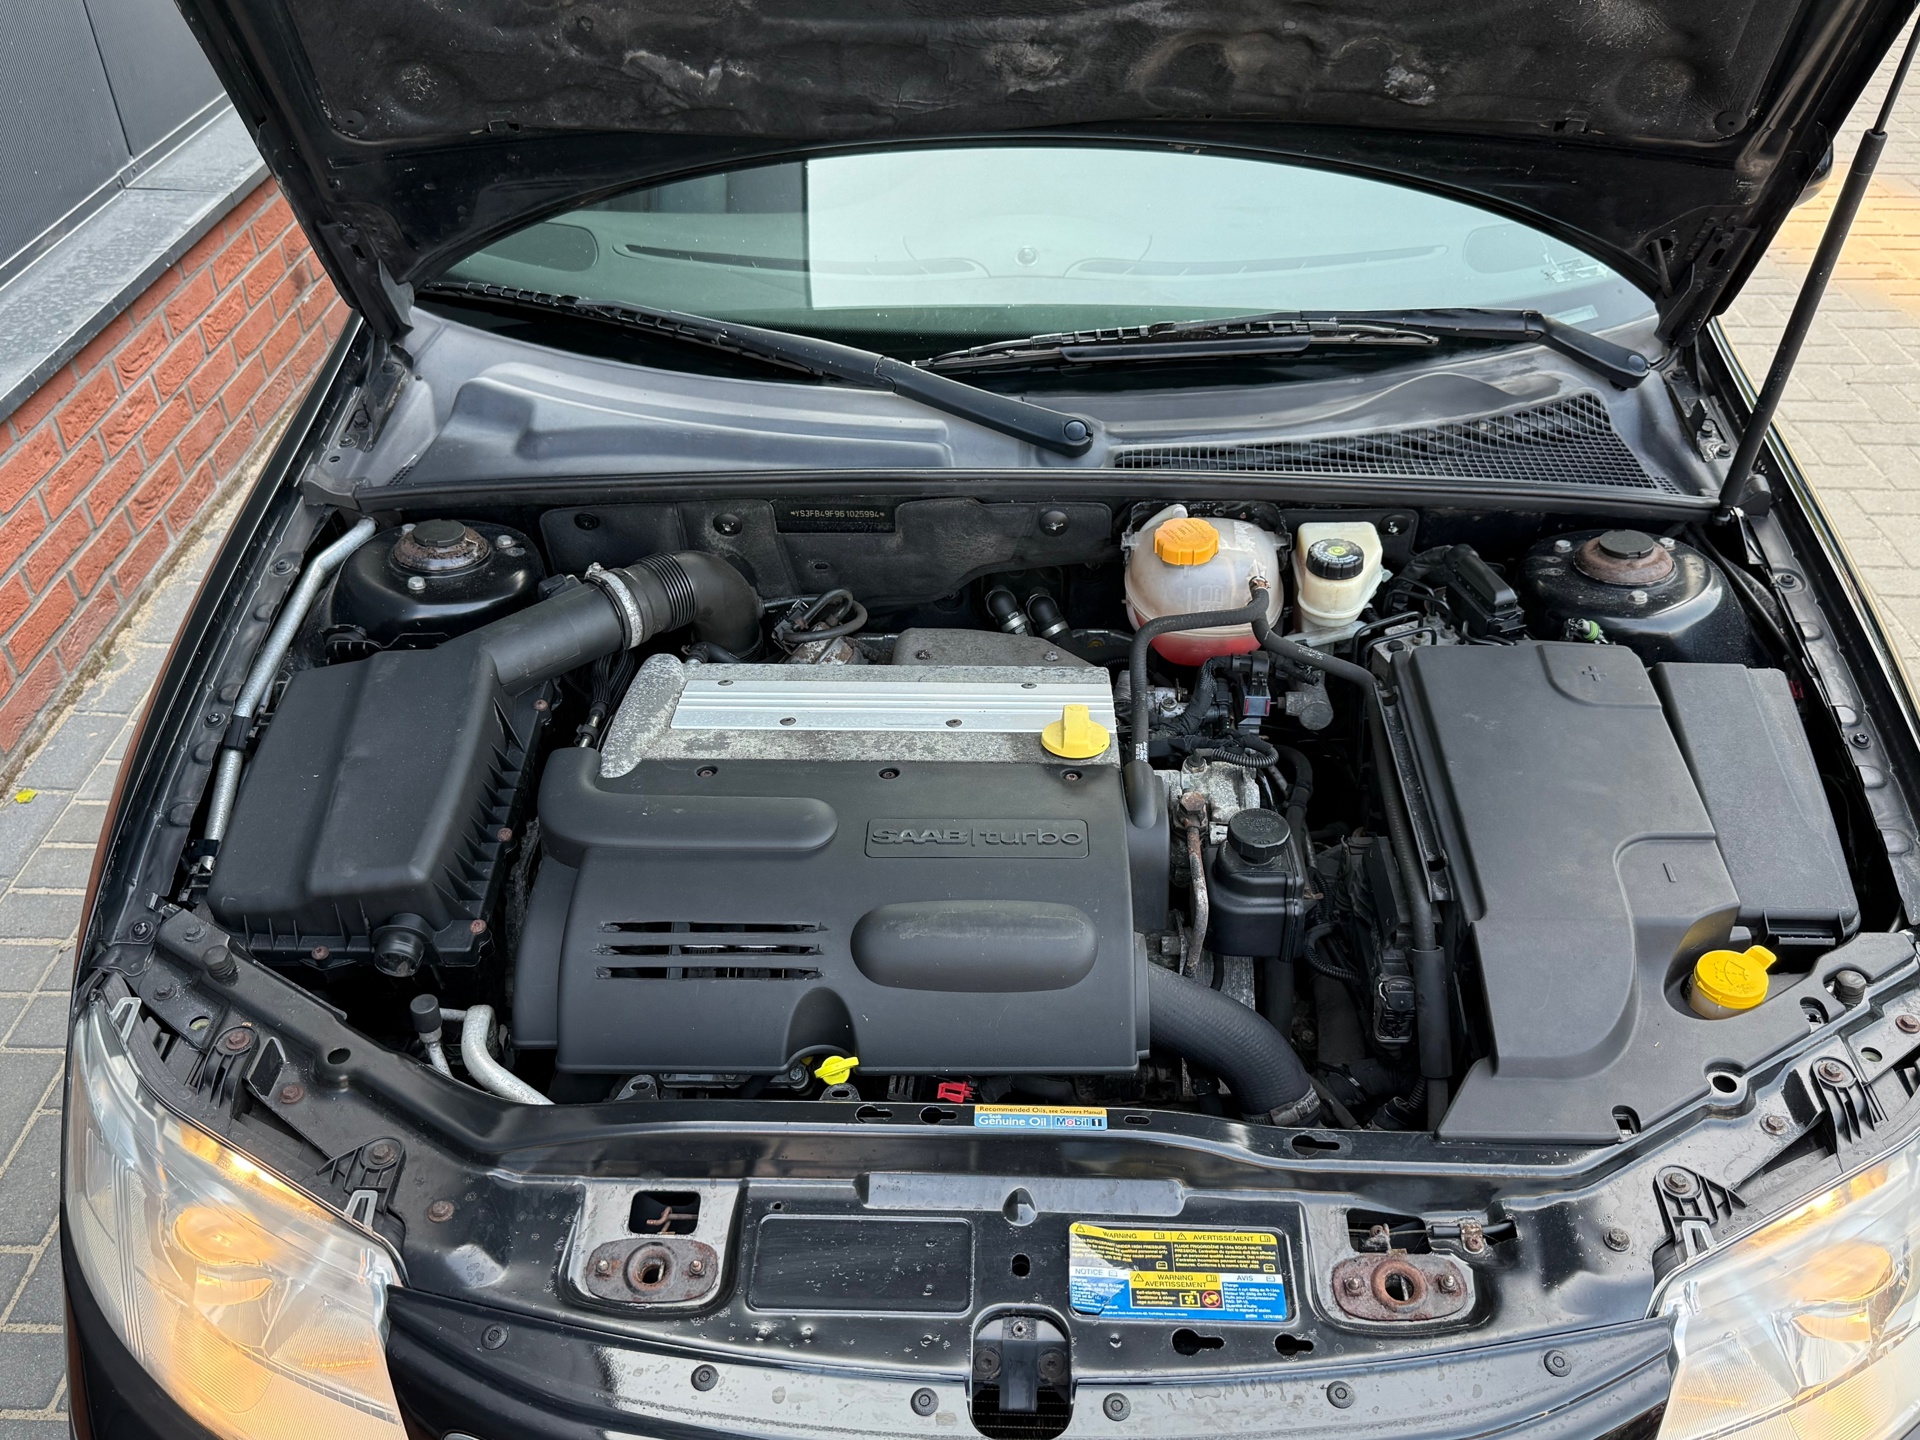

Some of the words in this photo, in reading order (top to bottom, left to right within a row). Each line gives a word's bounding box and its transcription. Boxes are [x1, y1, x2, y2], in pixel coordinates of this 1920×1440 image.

[871, 828, 968, 845] SAAB
[980, 828, 1083, 846] turbo
[978, 1115, 1026, 1126] Genuine
[1029, 1117, 1047, 1126] Oil
[1056, 1117, 1089, 1126] Mobil
[1102, 1231, 1138, 1239] WARNING
[1193, 1234, 1254, 1242] AVERTISSEMENT
[1075, 1268, 1104, 1276] NOTICE
